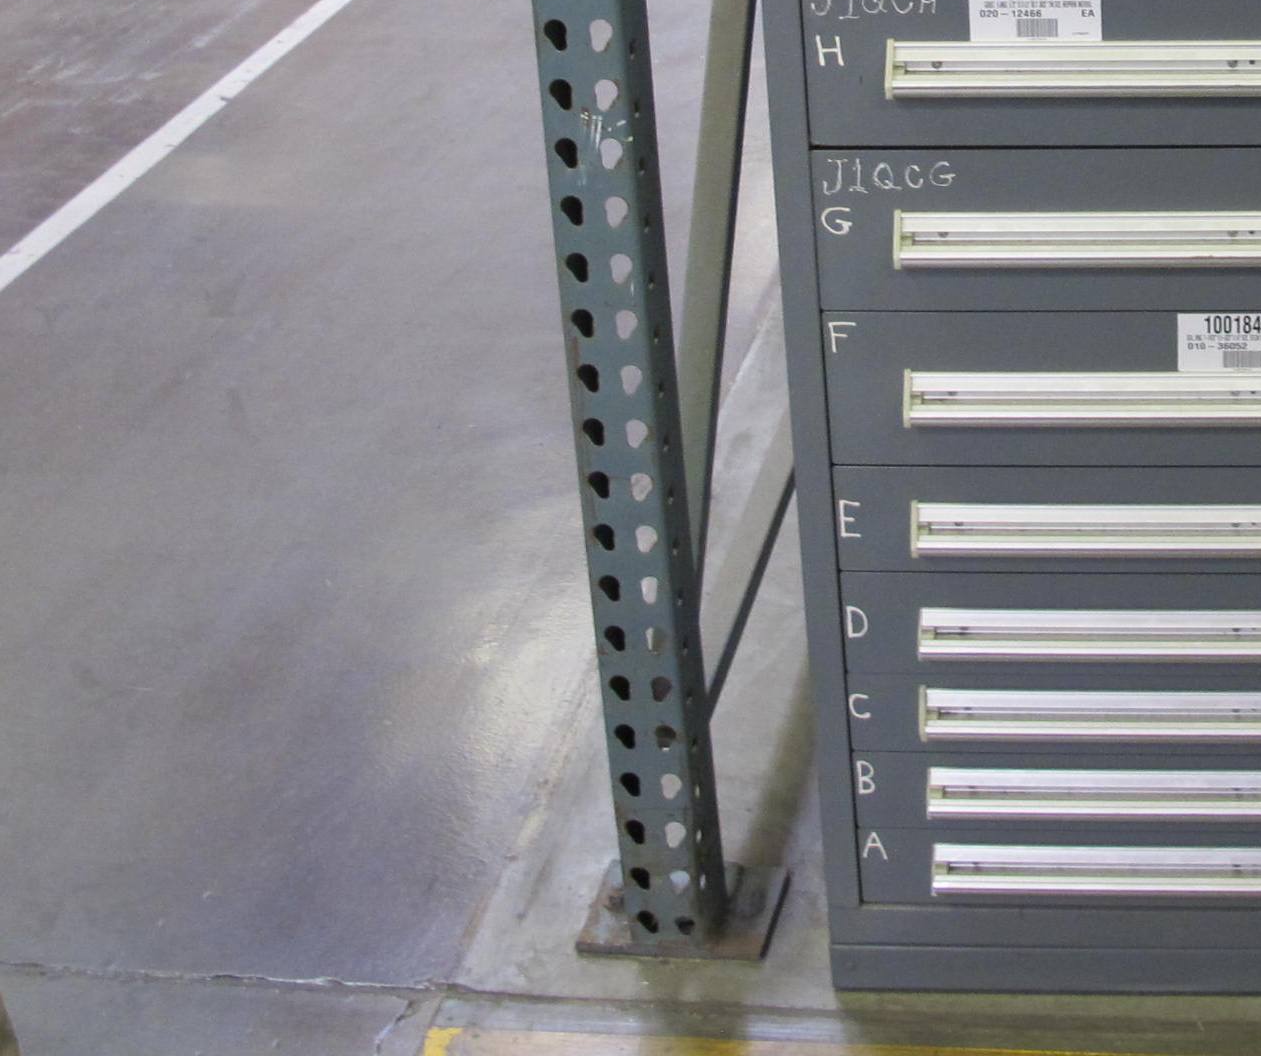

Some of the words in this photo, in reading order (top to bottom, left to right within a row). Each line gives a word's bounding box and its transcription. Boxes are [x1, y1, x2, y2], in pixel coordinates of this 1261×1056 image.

[1081, 9, 1095, 17] EA
[815, 34, 845, 67] H
[822, 158, 957, 195] J1QCG
[821, 207, 853, 235] G
[828, 321, 857, 353] F
[839, 499, 862, 538] E
[845, 605, 868, 639] D
[848, 693, 872, 719] C
[856, 760, 876, 795] B
[862, 831, 889, 861] A
